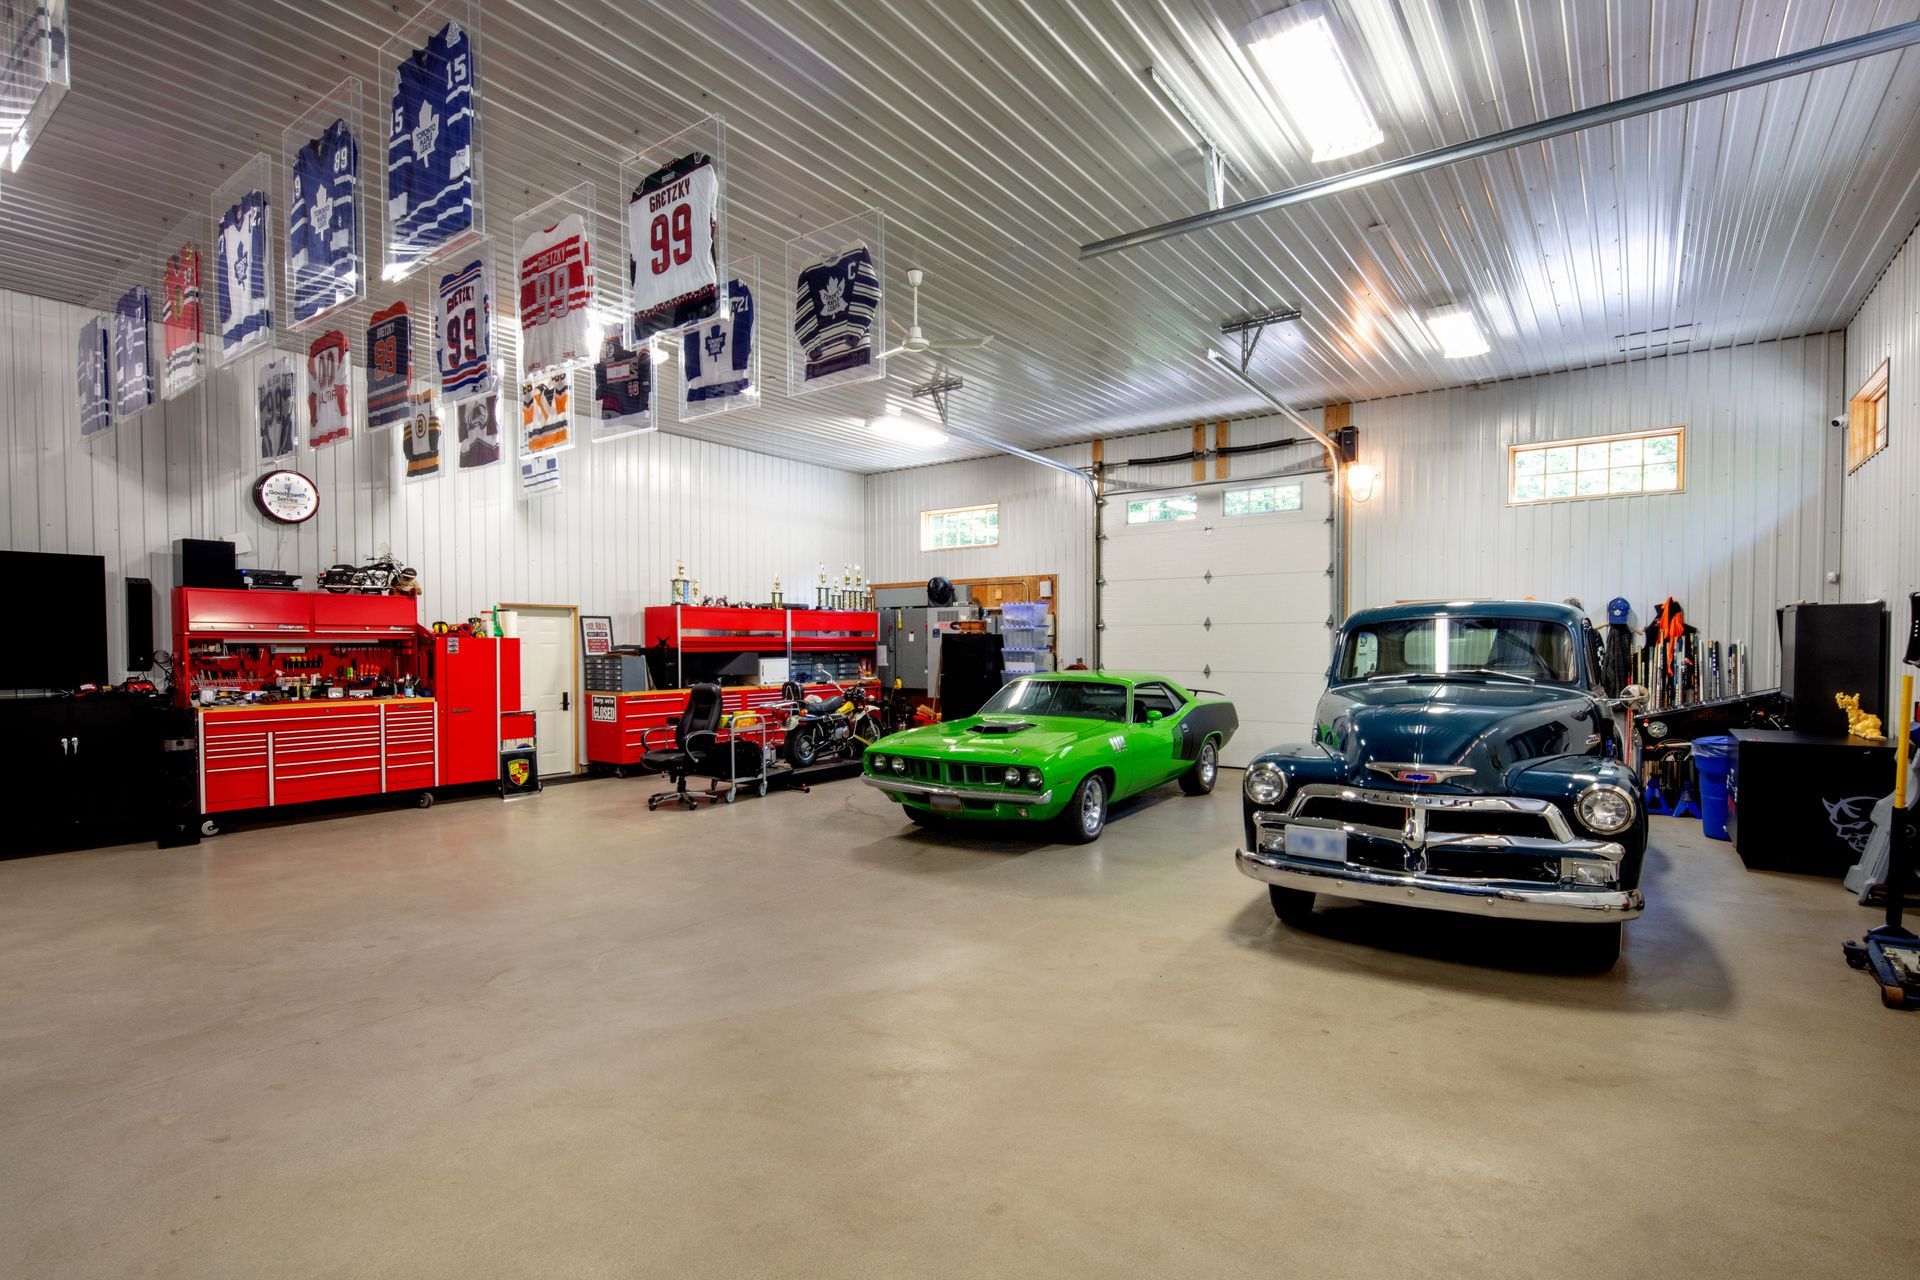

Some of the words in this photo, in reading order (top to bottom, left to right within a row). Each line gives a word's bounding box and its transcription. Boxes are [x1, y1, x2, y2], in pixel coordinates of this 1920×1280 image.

[446, 53, 467, 91] 15
[416, 123, 436, 141] TORONTO
[649, 177, 691, 213] GRETZKY
[650, 202, 692, 275] 99
[537, 245, 567, 271] GRETZKY
[847, 261, 857, 280] C
[447, 286, 475, 315] GRETZKY
[535, 265, 569, 326] 99
[823, 285, 842, 301] TORONTO
[376, 322, 395, 339] GRETZKY
[446, 307, 477, 369] 99
[374, 335, 397, 381] 99
[593, 706, 615, 720] CLOSED
[1361, 792, 1474, 807] CHEVOLET
